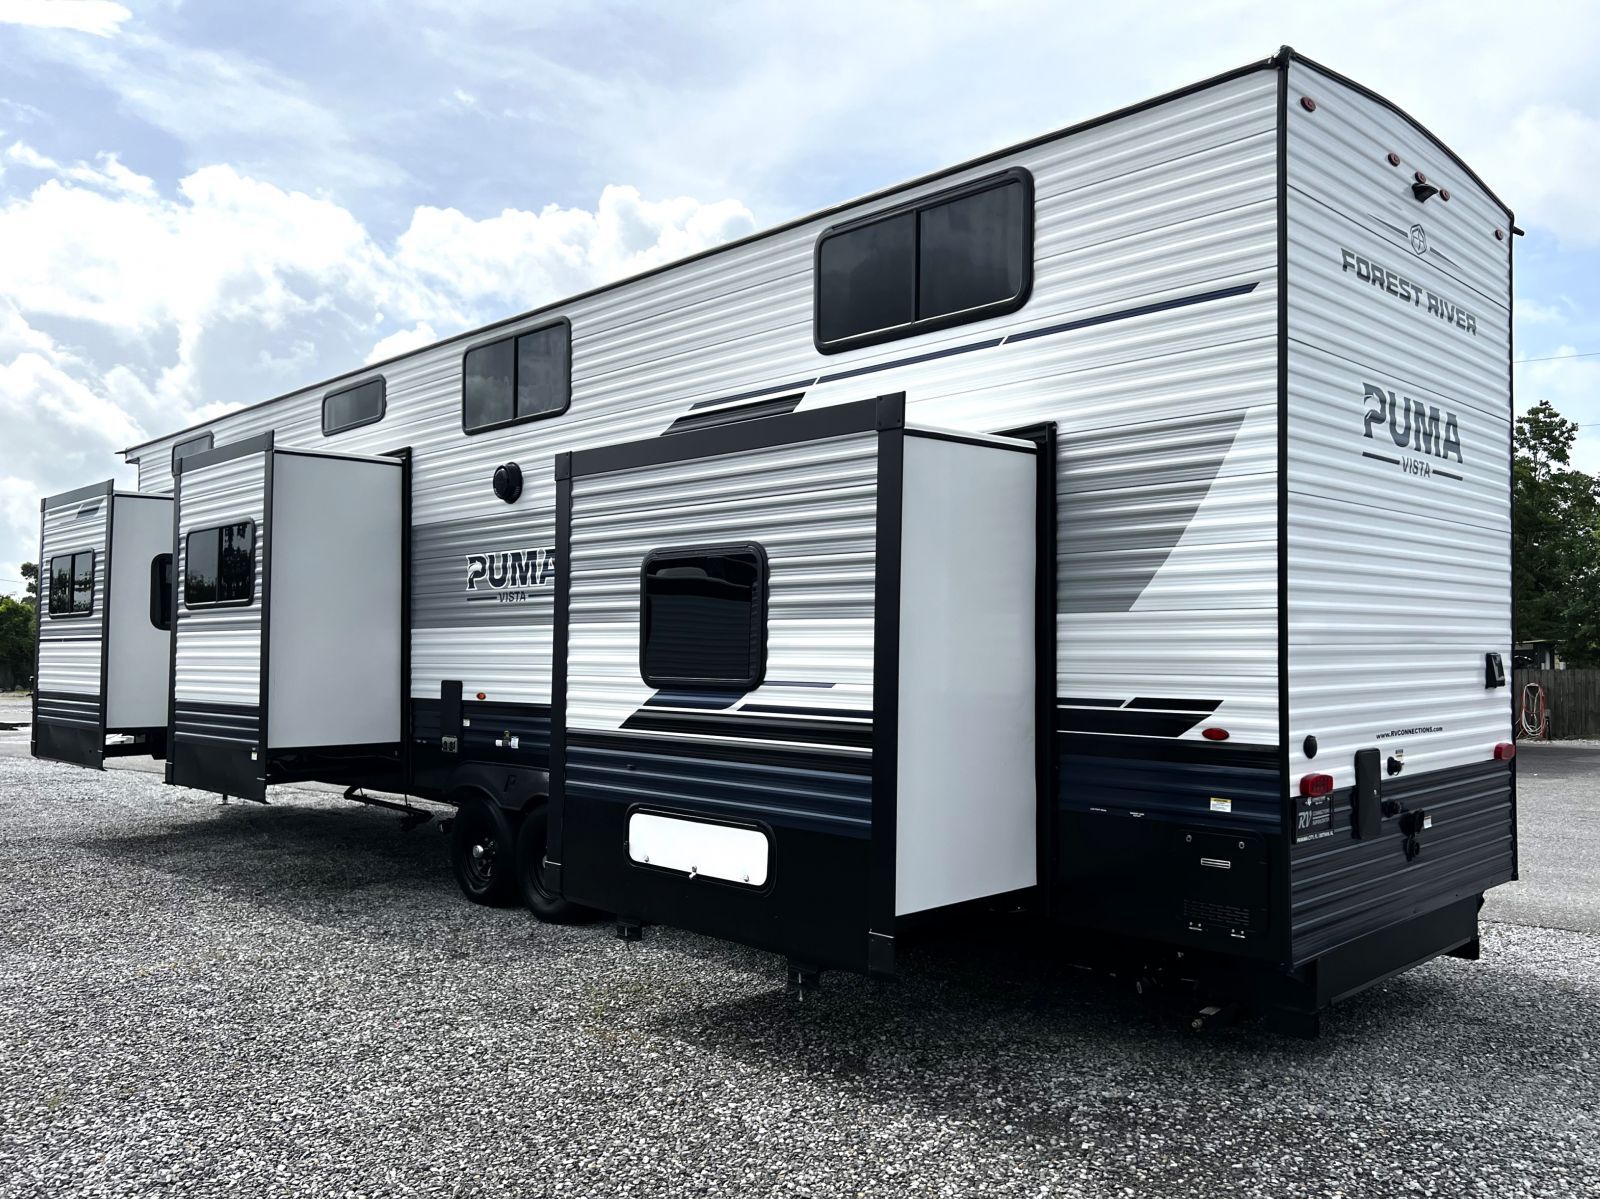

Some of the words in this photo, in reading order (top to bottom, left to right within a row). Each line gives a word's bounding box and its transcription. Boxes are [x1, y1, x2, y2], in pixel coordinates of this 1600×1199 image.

[1341, 248, 1422, 307] FOREST
[1426, 292, 1477, 336] RIVER
[1362, 382, 1463, 464] PUMA
[1401, 456, 1431, 478] VISTA
[499, 591, 526, 602] VISTA
[1298, 810, 1312, 829] RV
